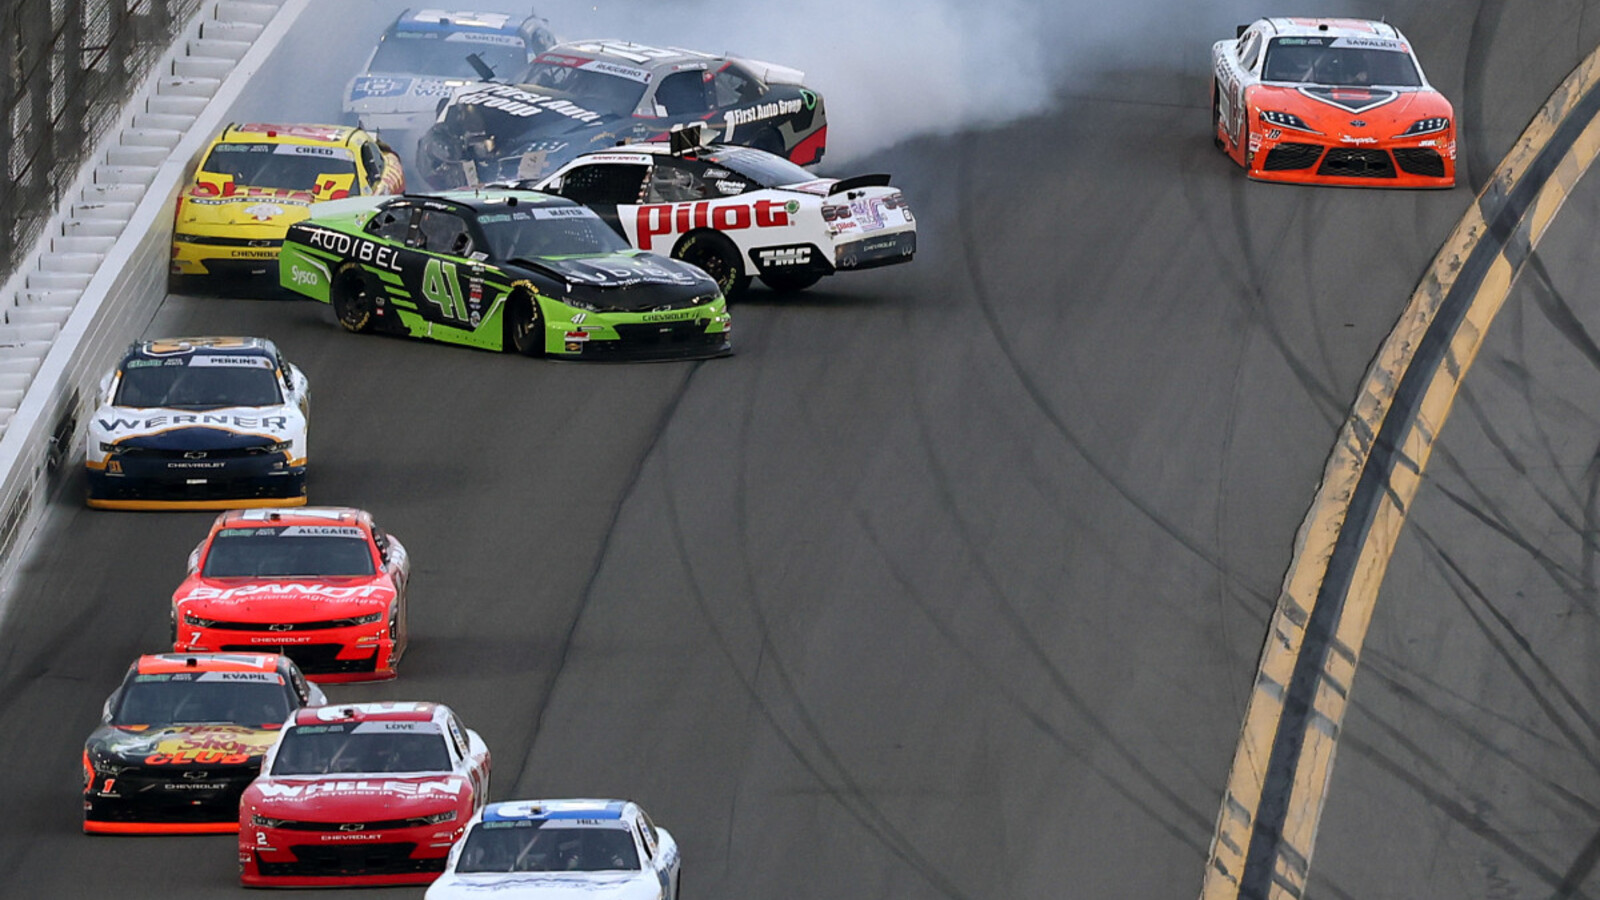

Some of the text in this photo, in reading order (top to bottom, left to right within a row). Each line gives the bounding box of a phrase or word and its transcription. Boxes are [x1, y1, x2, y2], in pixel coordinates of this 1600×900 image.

[1346, 39, 1397, 48] SAWALICH
[596, 63, 642, 77] RUGGIERO
[735, 108, 757, 125] First
[757, 102, 779, 120] Auto
[778, 99, 802, 115] Group
[295, 146, 334, 156] CREED
[548, 208, 584, 217] MAYER
[636, 199, 789, 250] pilot
[310, 232, 403, 272] AUDIBEL
[863, 240, 897, 252] CHEVROLET
[231, 250, 280, 258] CHEVROL
[759, 247, 812, 267] TMC
[291, 265, 318, 285] Sysco
[422, 258, 469, 322] 41
[570, 313, 587, 325] 41
[642, 312, 690, 323] CHEVROLET
[210, 357, 258, 365] PERKINS
[98, 415, 287, 431] WERNER
[298, 527, 358, 535] ALLGAIER
[180, 583, 393, 605] BRANDT
[189, 631, 202, 645] 7
[144, 751, 251, 766] CLUB
[102, 778, 116, 793] 1
[255, 778, 463, 797] WHELEN
[262, 790, 375, 803] MANUFACTURED
[396, 792, 458, 803] AMERICA
[255, 831, 268, 845] 2
